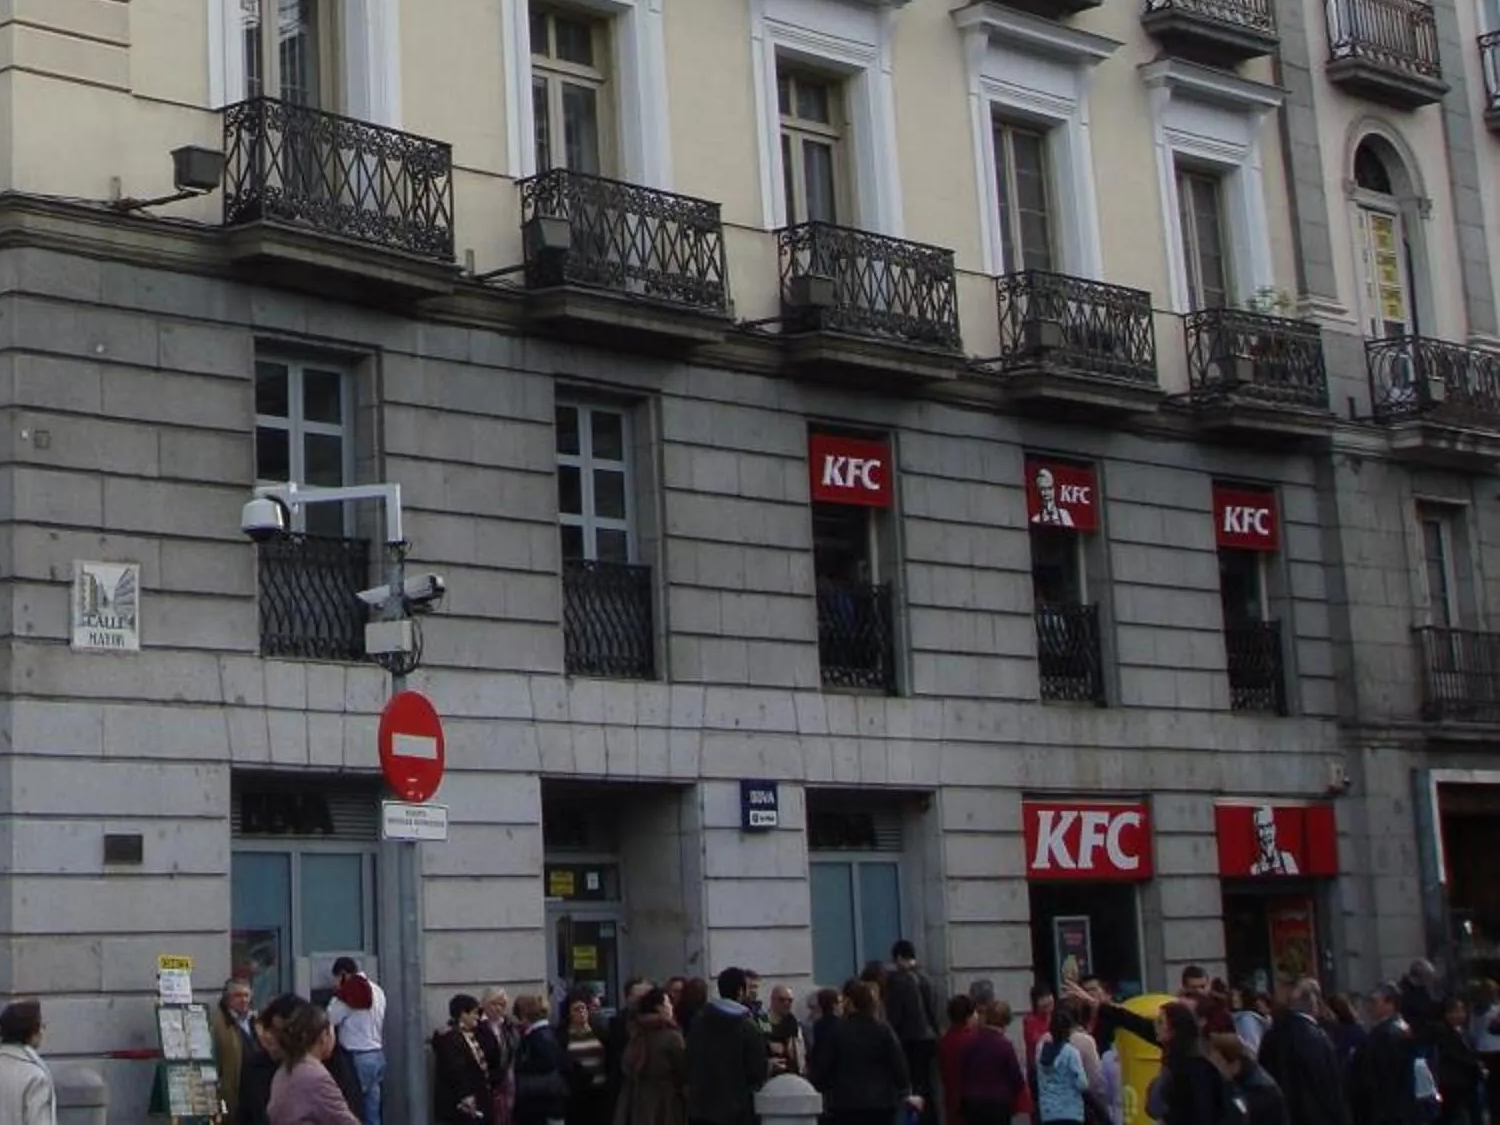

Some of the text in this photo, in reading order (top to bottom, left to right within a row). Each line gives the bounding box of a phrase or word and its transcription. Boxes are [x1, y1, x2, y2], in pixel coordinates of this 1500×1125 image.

[823, 454, 881, 491] KFC
[1060, 484, 1091, 506] KFC
[1223, 505, 1270, 536] KFC
[88, 615, 124, 629] CALLE
[1032, 809, 1142, 870] KFC
